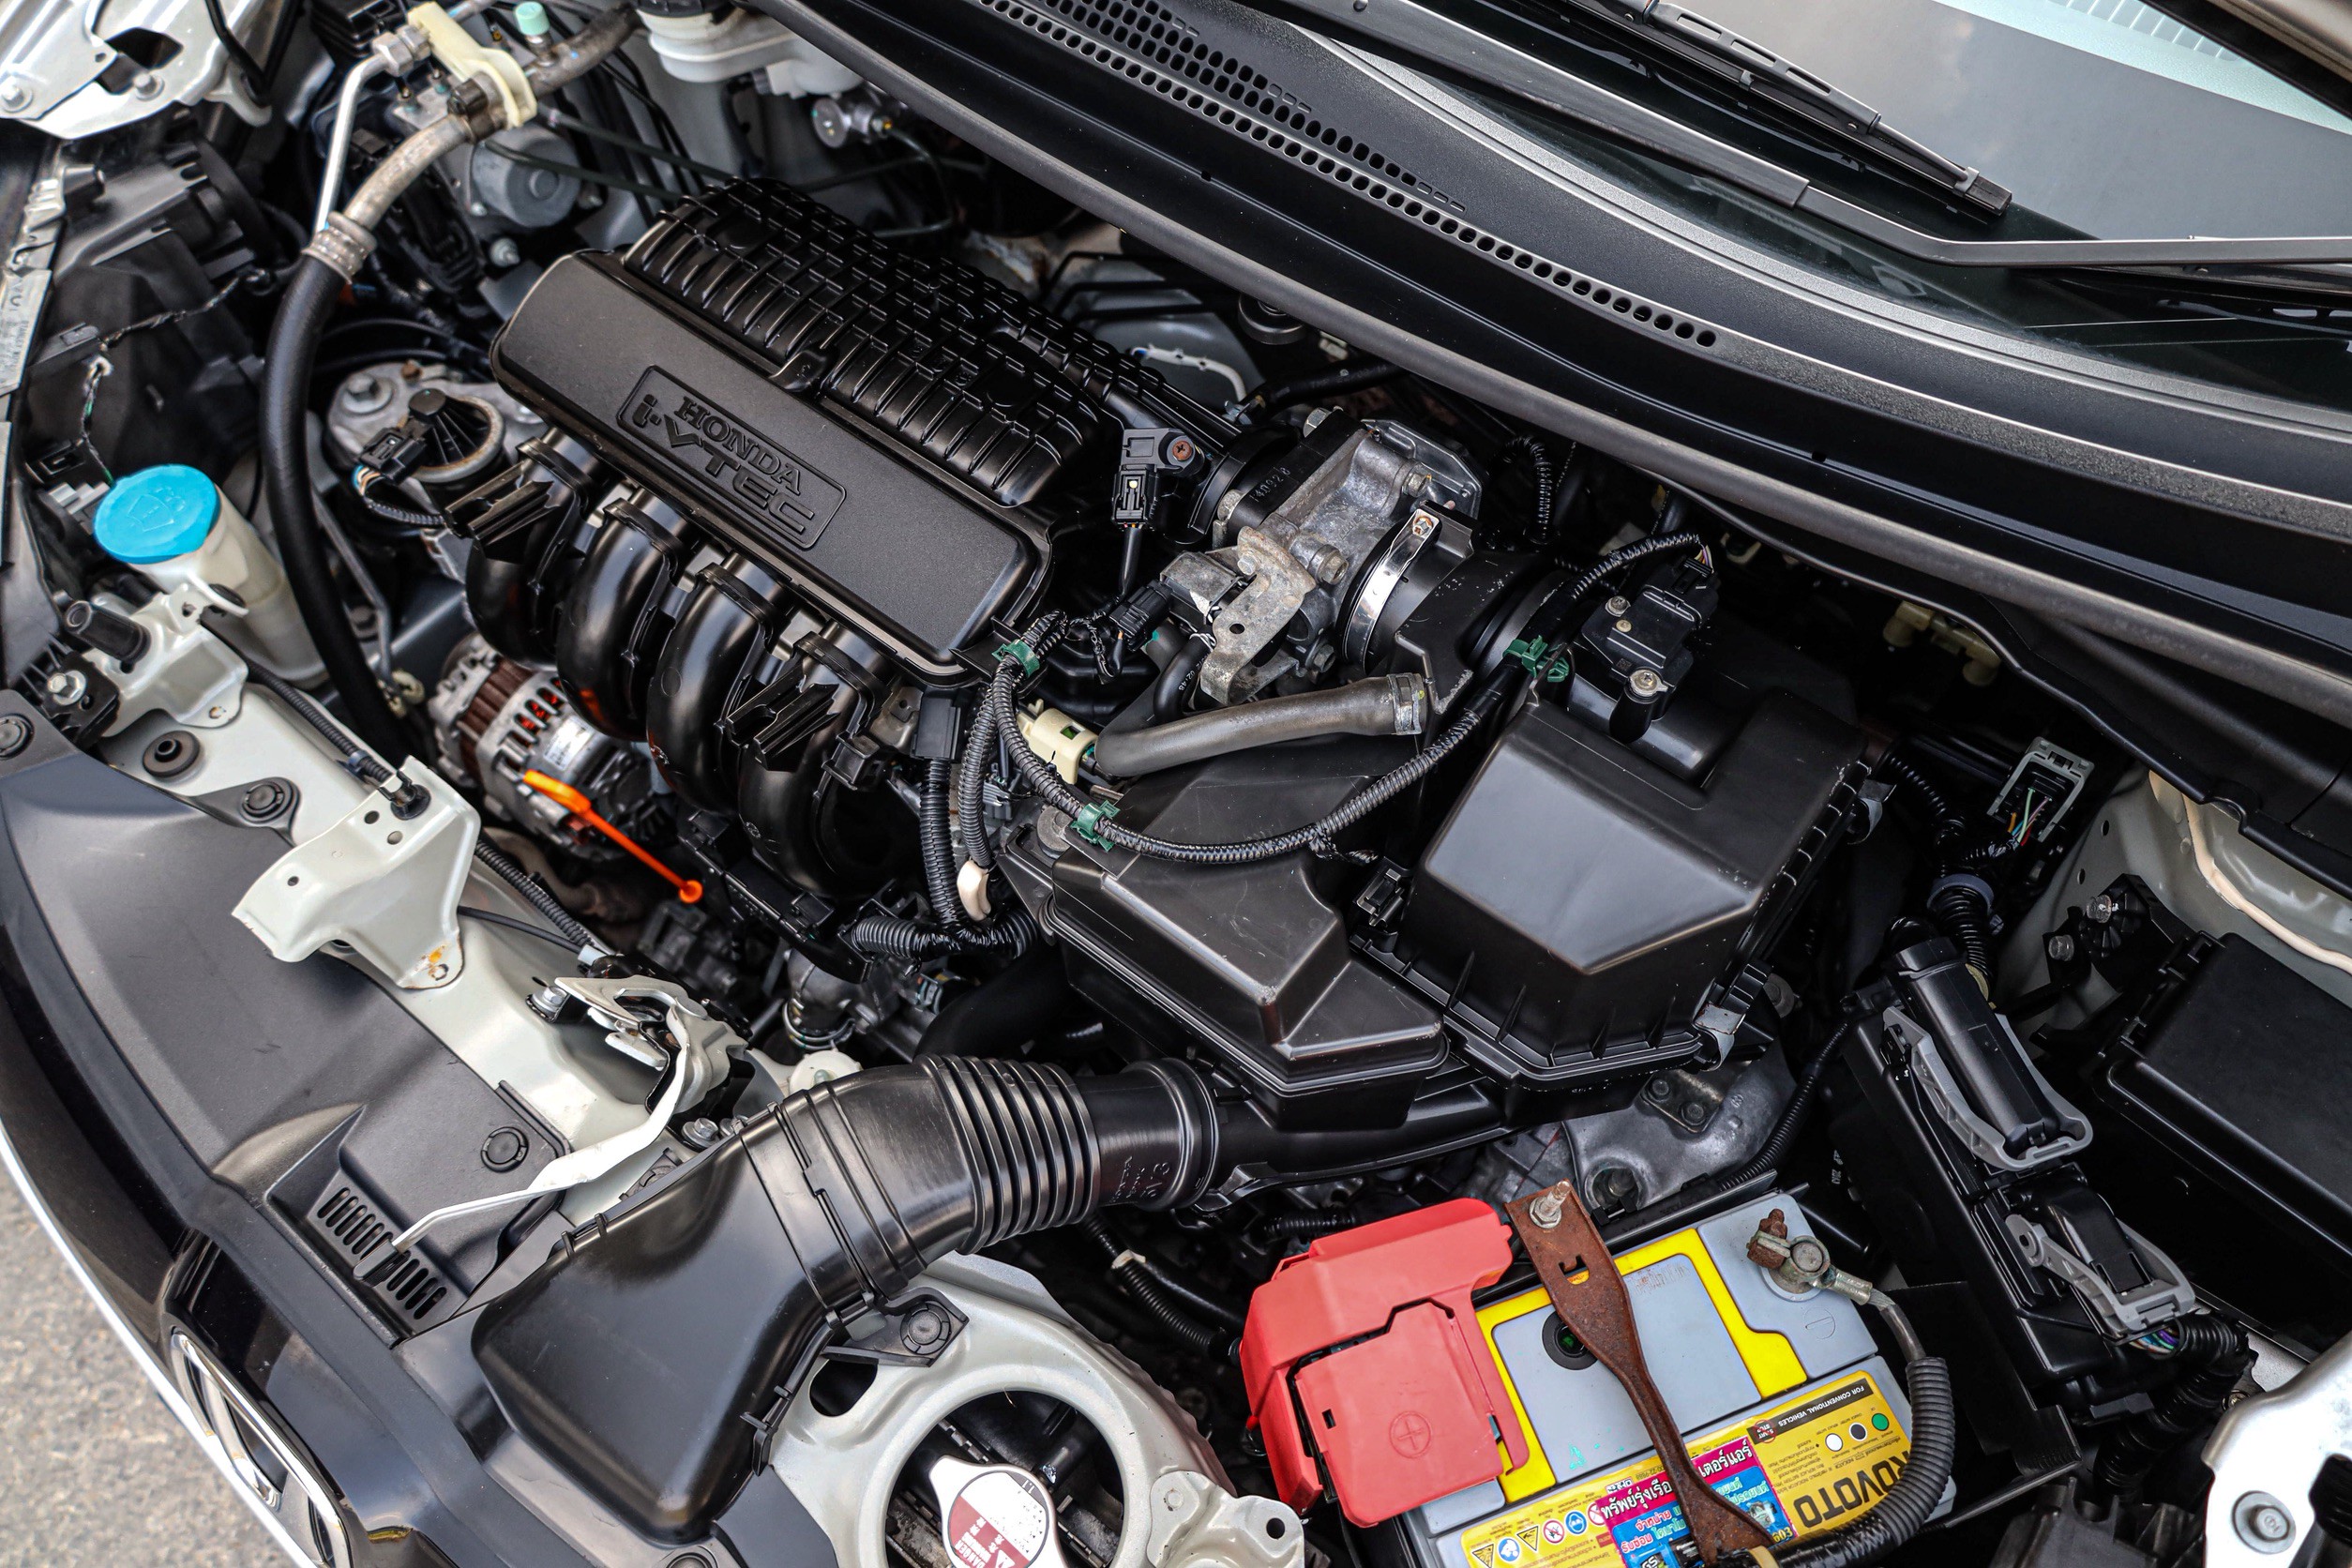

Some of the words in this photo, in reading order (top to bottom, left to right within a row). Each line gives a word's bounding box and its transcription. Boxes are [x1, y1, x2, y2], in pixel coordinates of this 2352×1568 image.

[673, 396, 802, 497] HONDA
[1852, 1385, 1865, 1395] FOR
[1807, 1391, 1851, 1414] CONVENTIONAL
[1778, 1409, 1807, 1427] VEHICLES
[1600, 1478, 1673, 1520] ทรัพย์รุ่งเรือ
[1697, 1439, 1754, 1478] เตอร์แอร์
[1772, 1526, 1794, 1543] 603
